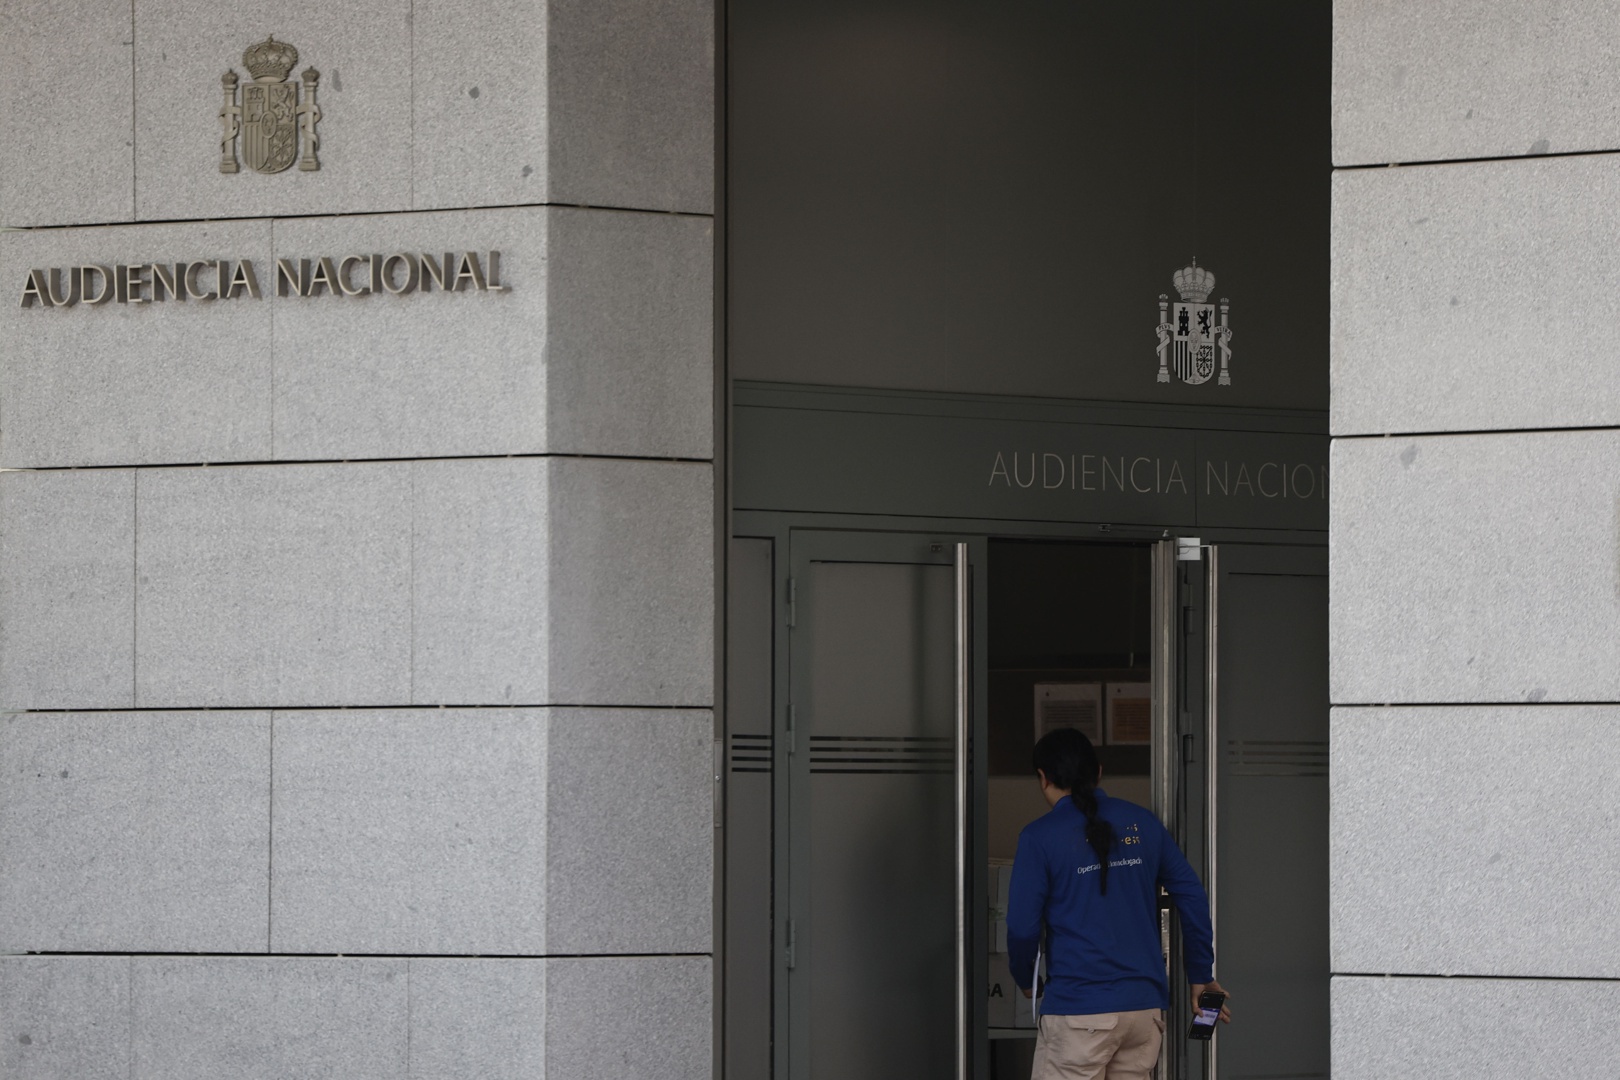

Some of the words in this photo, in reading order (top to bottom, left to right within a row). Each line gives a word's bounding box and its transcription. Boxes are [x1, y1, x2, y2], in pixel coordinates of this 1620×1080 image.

[20, 258, 262, 308] AUDIENCIA
[276, 250, 510, 298] NACIONAL
[988, 451, 1188, 495] AUDIENCIA
